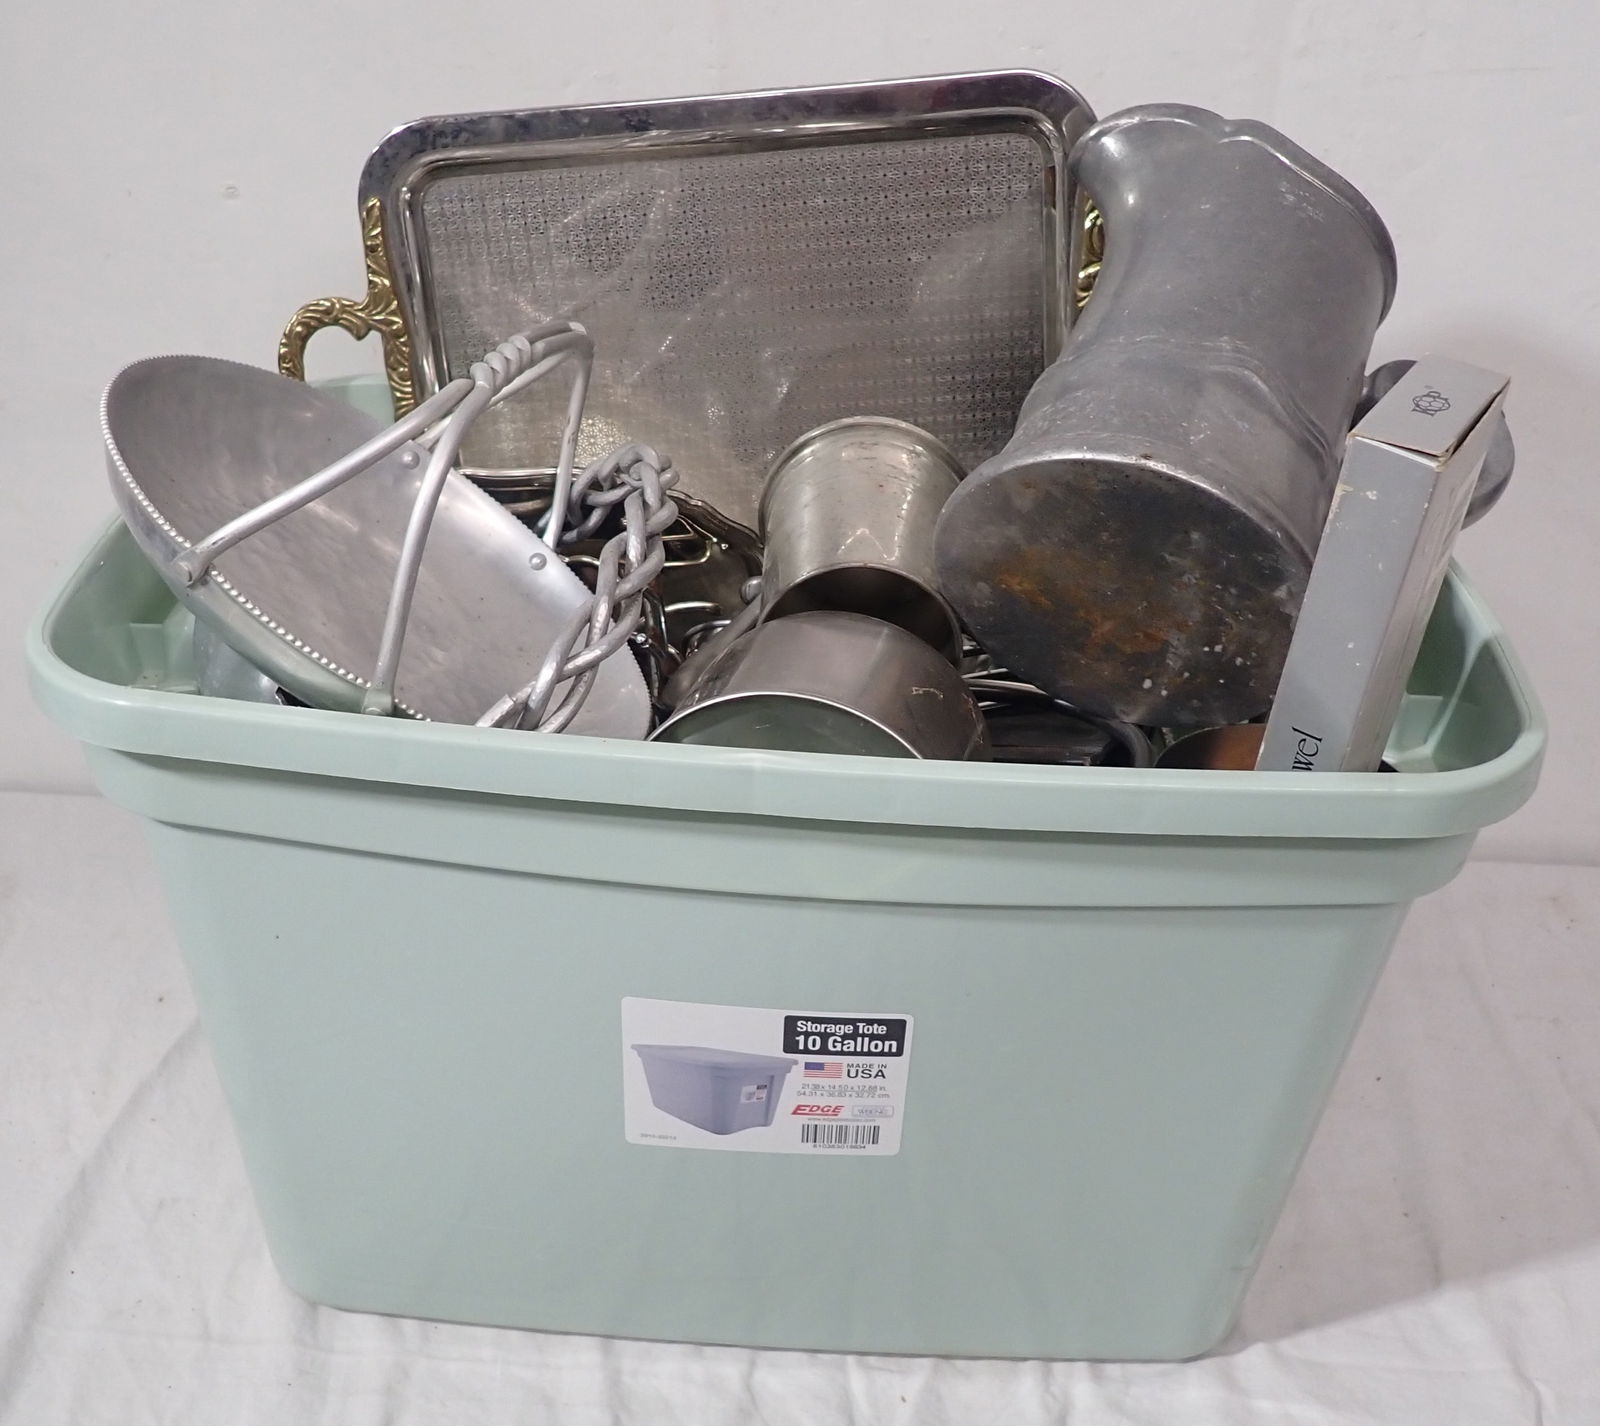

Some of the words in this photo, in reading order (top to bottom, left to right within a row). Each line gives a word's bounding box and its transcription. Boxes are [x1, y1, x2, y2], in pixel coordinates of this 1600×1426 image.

[796, 1020, 853, 1035] Storage
[856, 1022, 887, 1034] Tote
[795, 1035, 821, 1051] 10
[828, 1036, 897, 1053] Gallon
[847, 1069, 886, 1079] USA
[791, 1104, 845, 1116] EDGE
